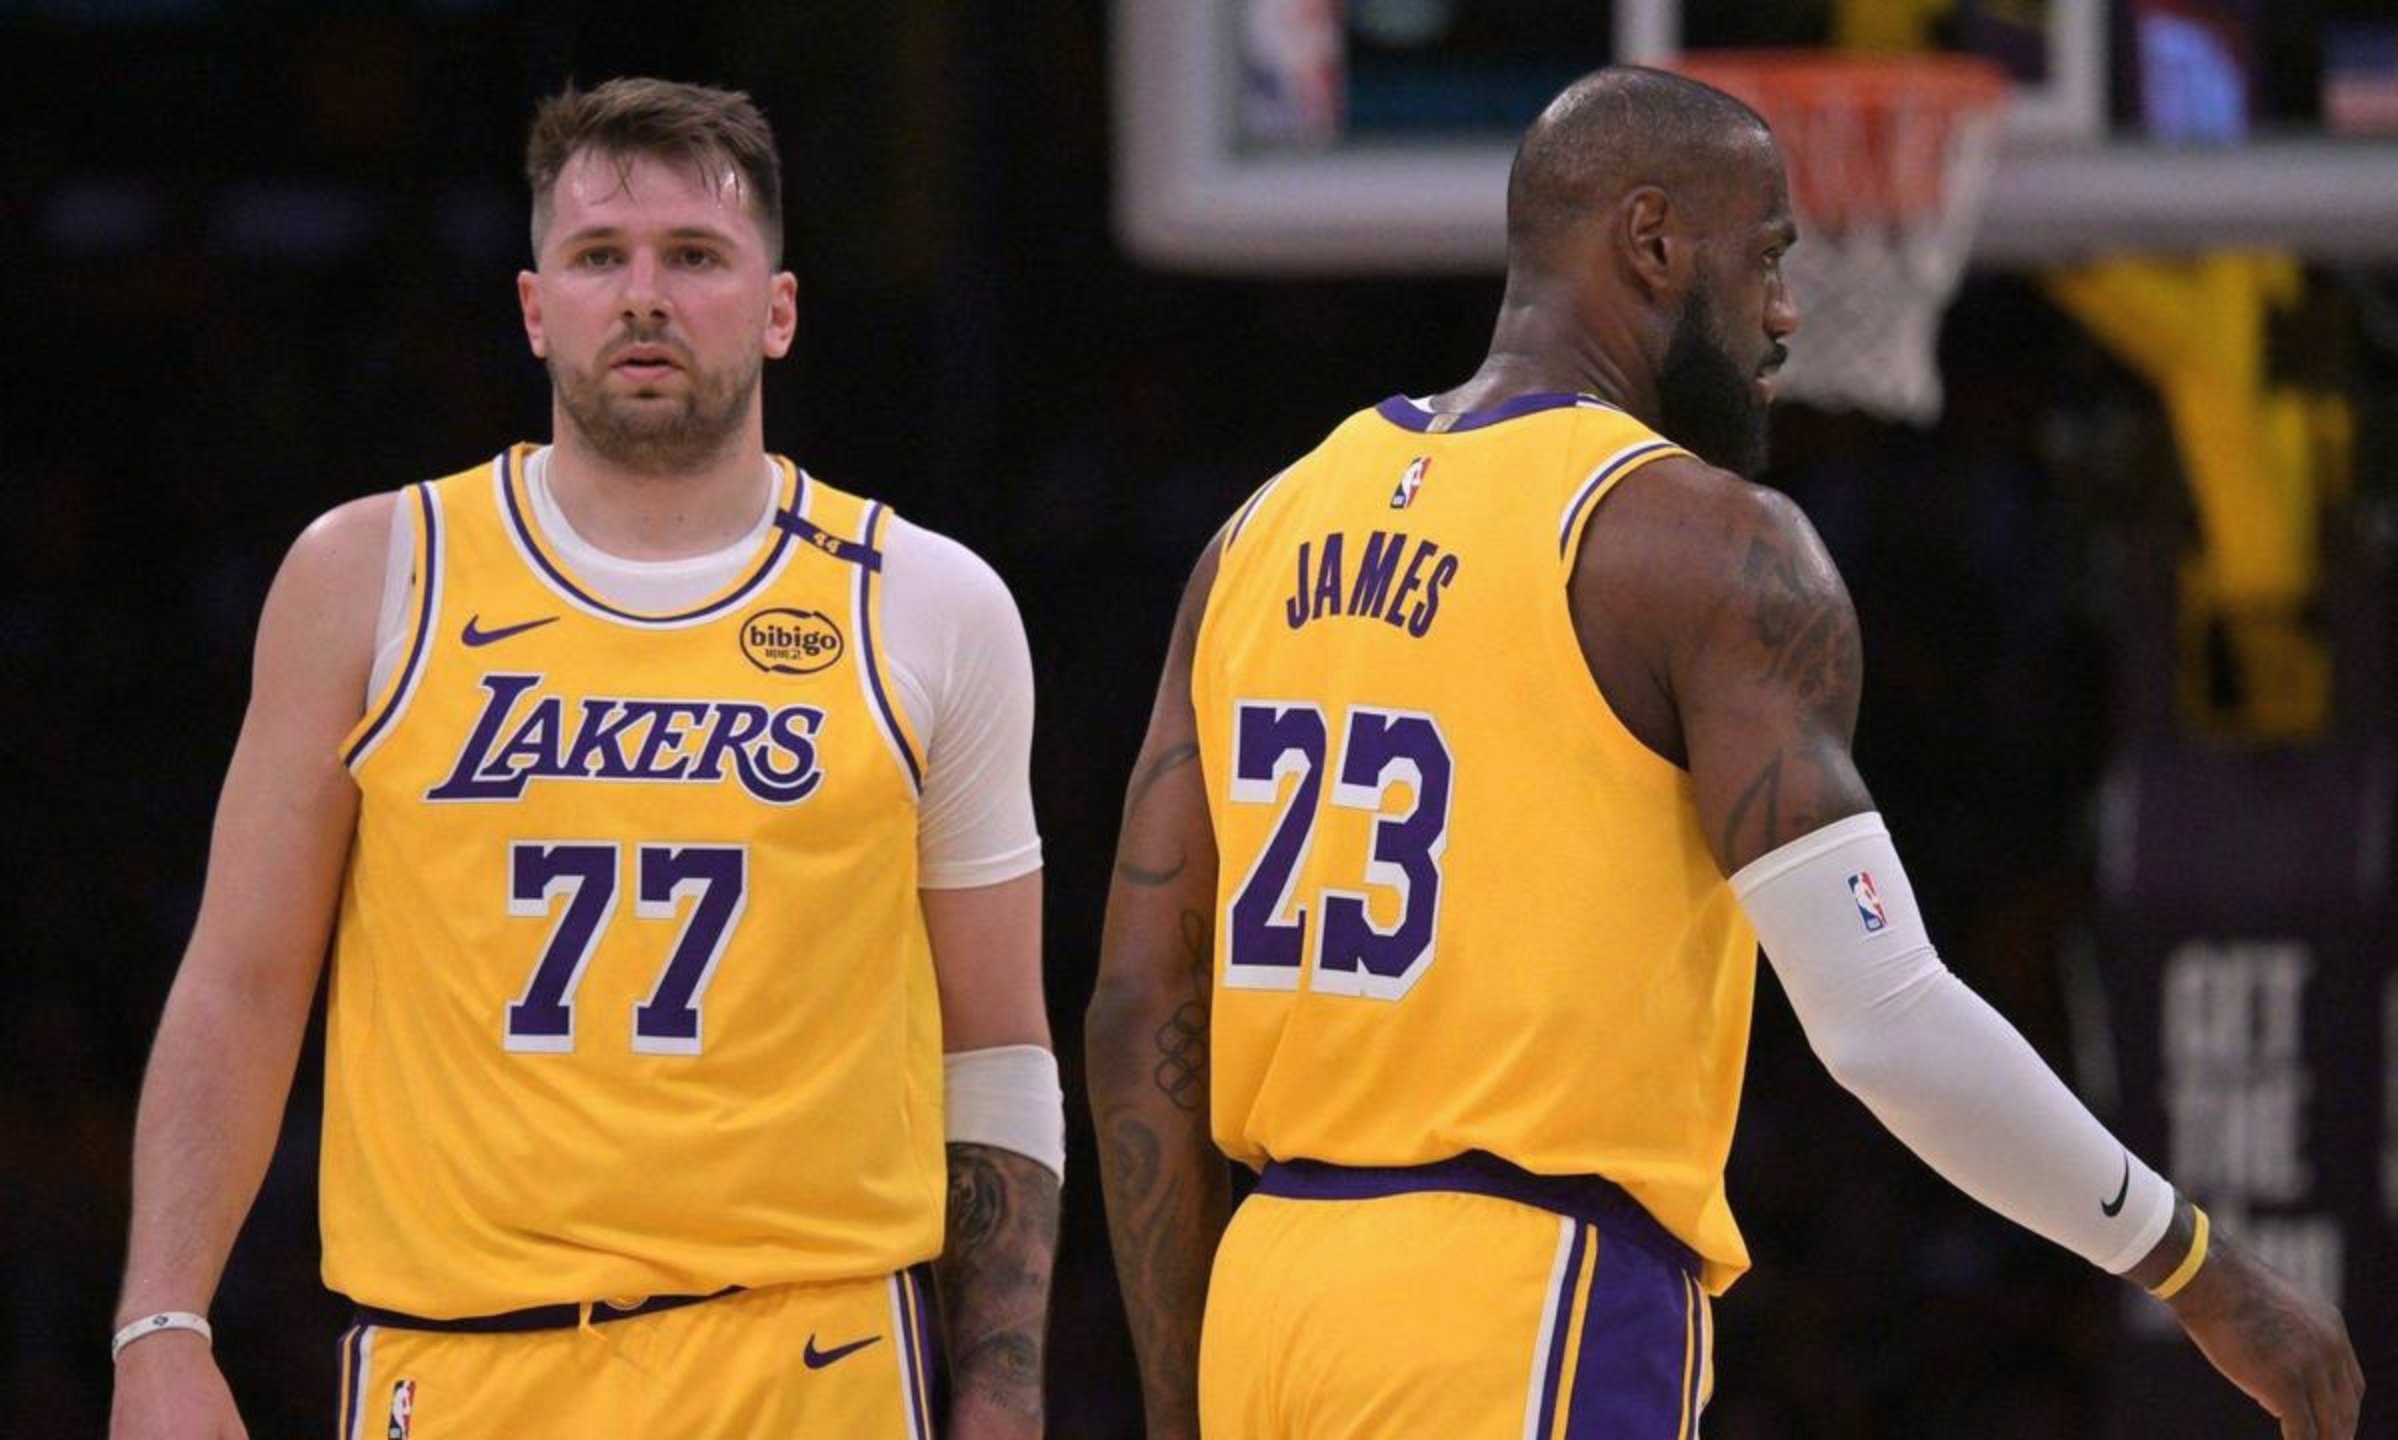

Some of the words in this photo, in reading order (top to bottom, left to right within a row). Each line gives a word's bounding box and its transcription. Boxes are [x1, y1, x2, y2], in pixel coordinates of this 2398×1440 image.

[750, 625, 837, 656] bibigo
[1286, 531, 1459, 637] JAMES
[421, 673, 824, 803] LAKERS
[1222, 699, 1454, 1002] 23
[505, 840, 748, 1055] 77
